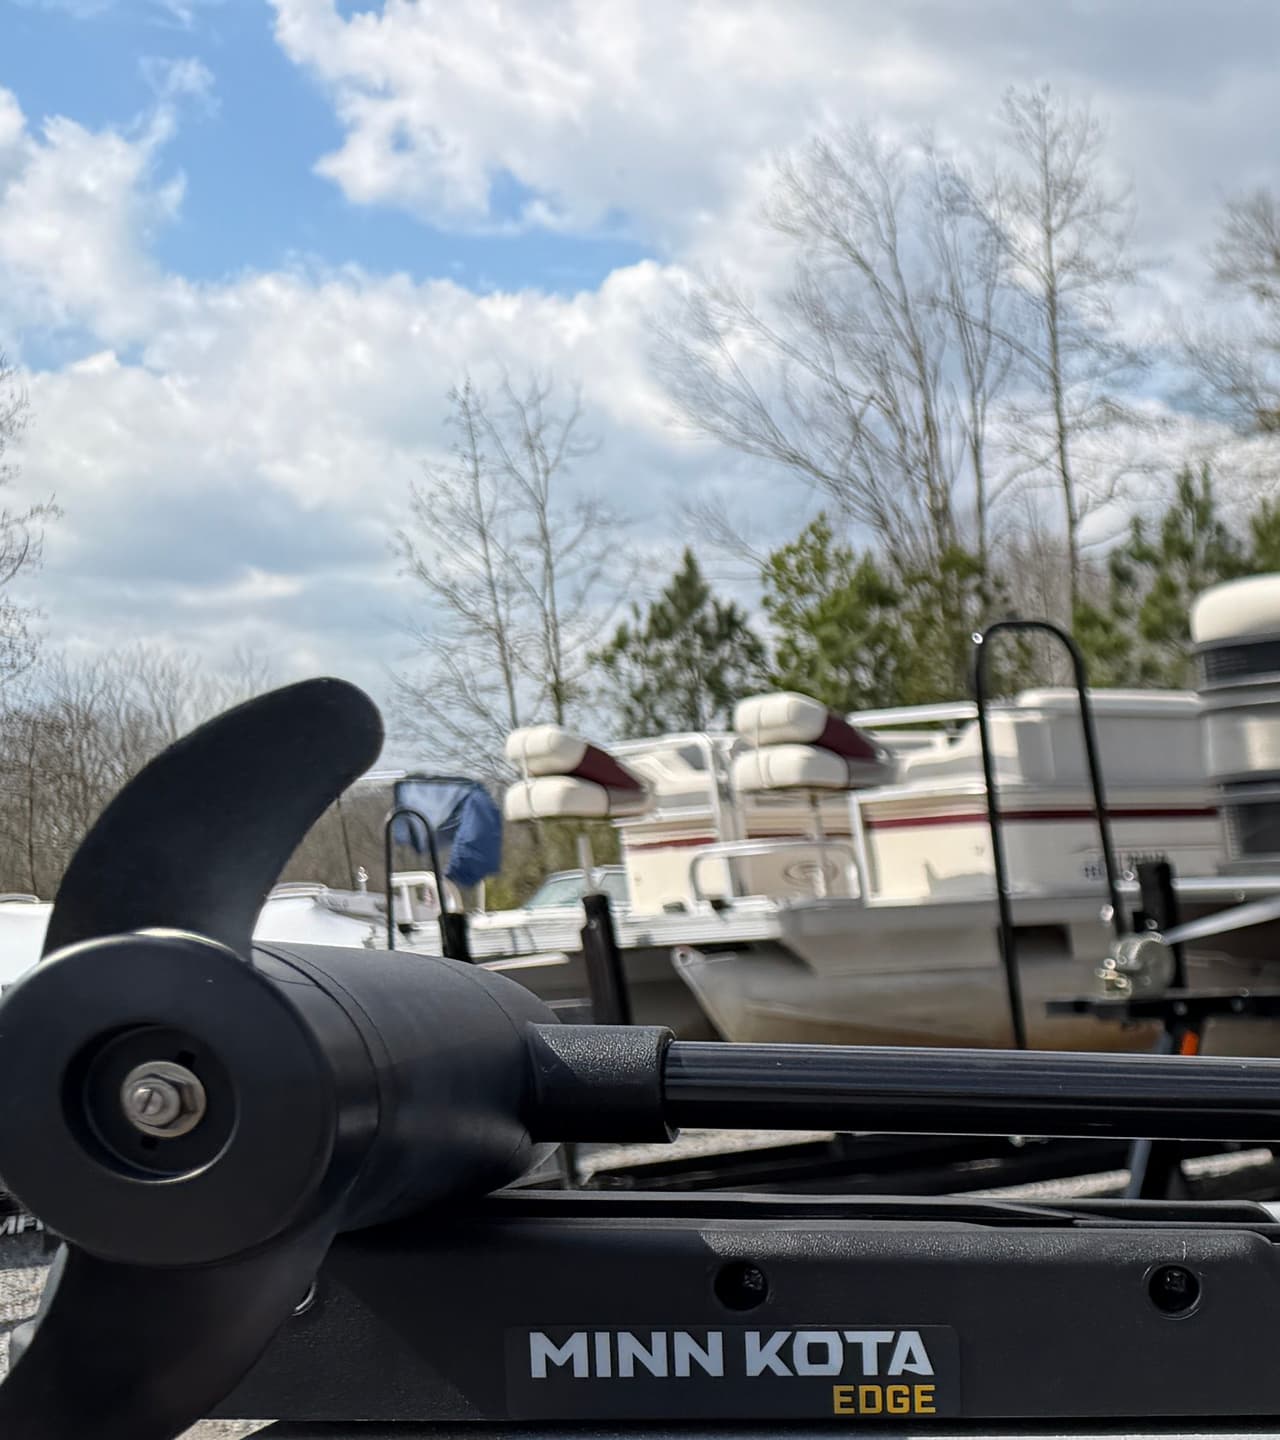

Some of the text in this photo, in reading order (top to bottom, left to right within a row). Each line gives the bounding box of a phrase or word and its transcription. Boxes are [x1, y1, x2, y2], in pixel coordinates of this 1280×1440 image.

[528, 1330, 936, 1379] MINN KOTA
[832, 1384, 937, 1415] EDGE
